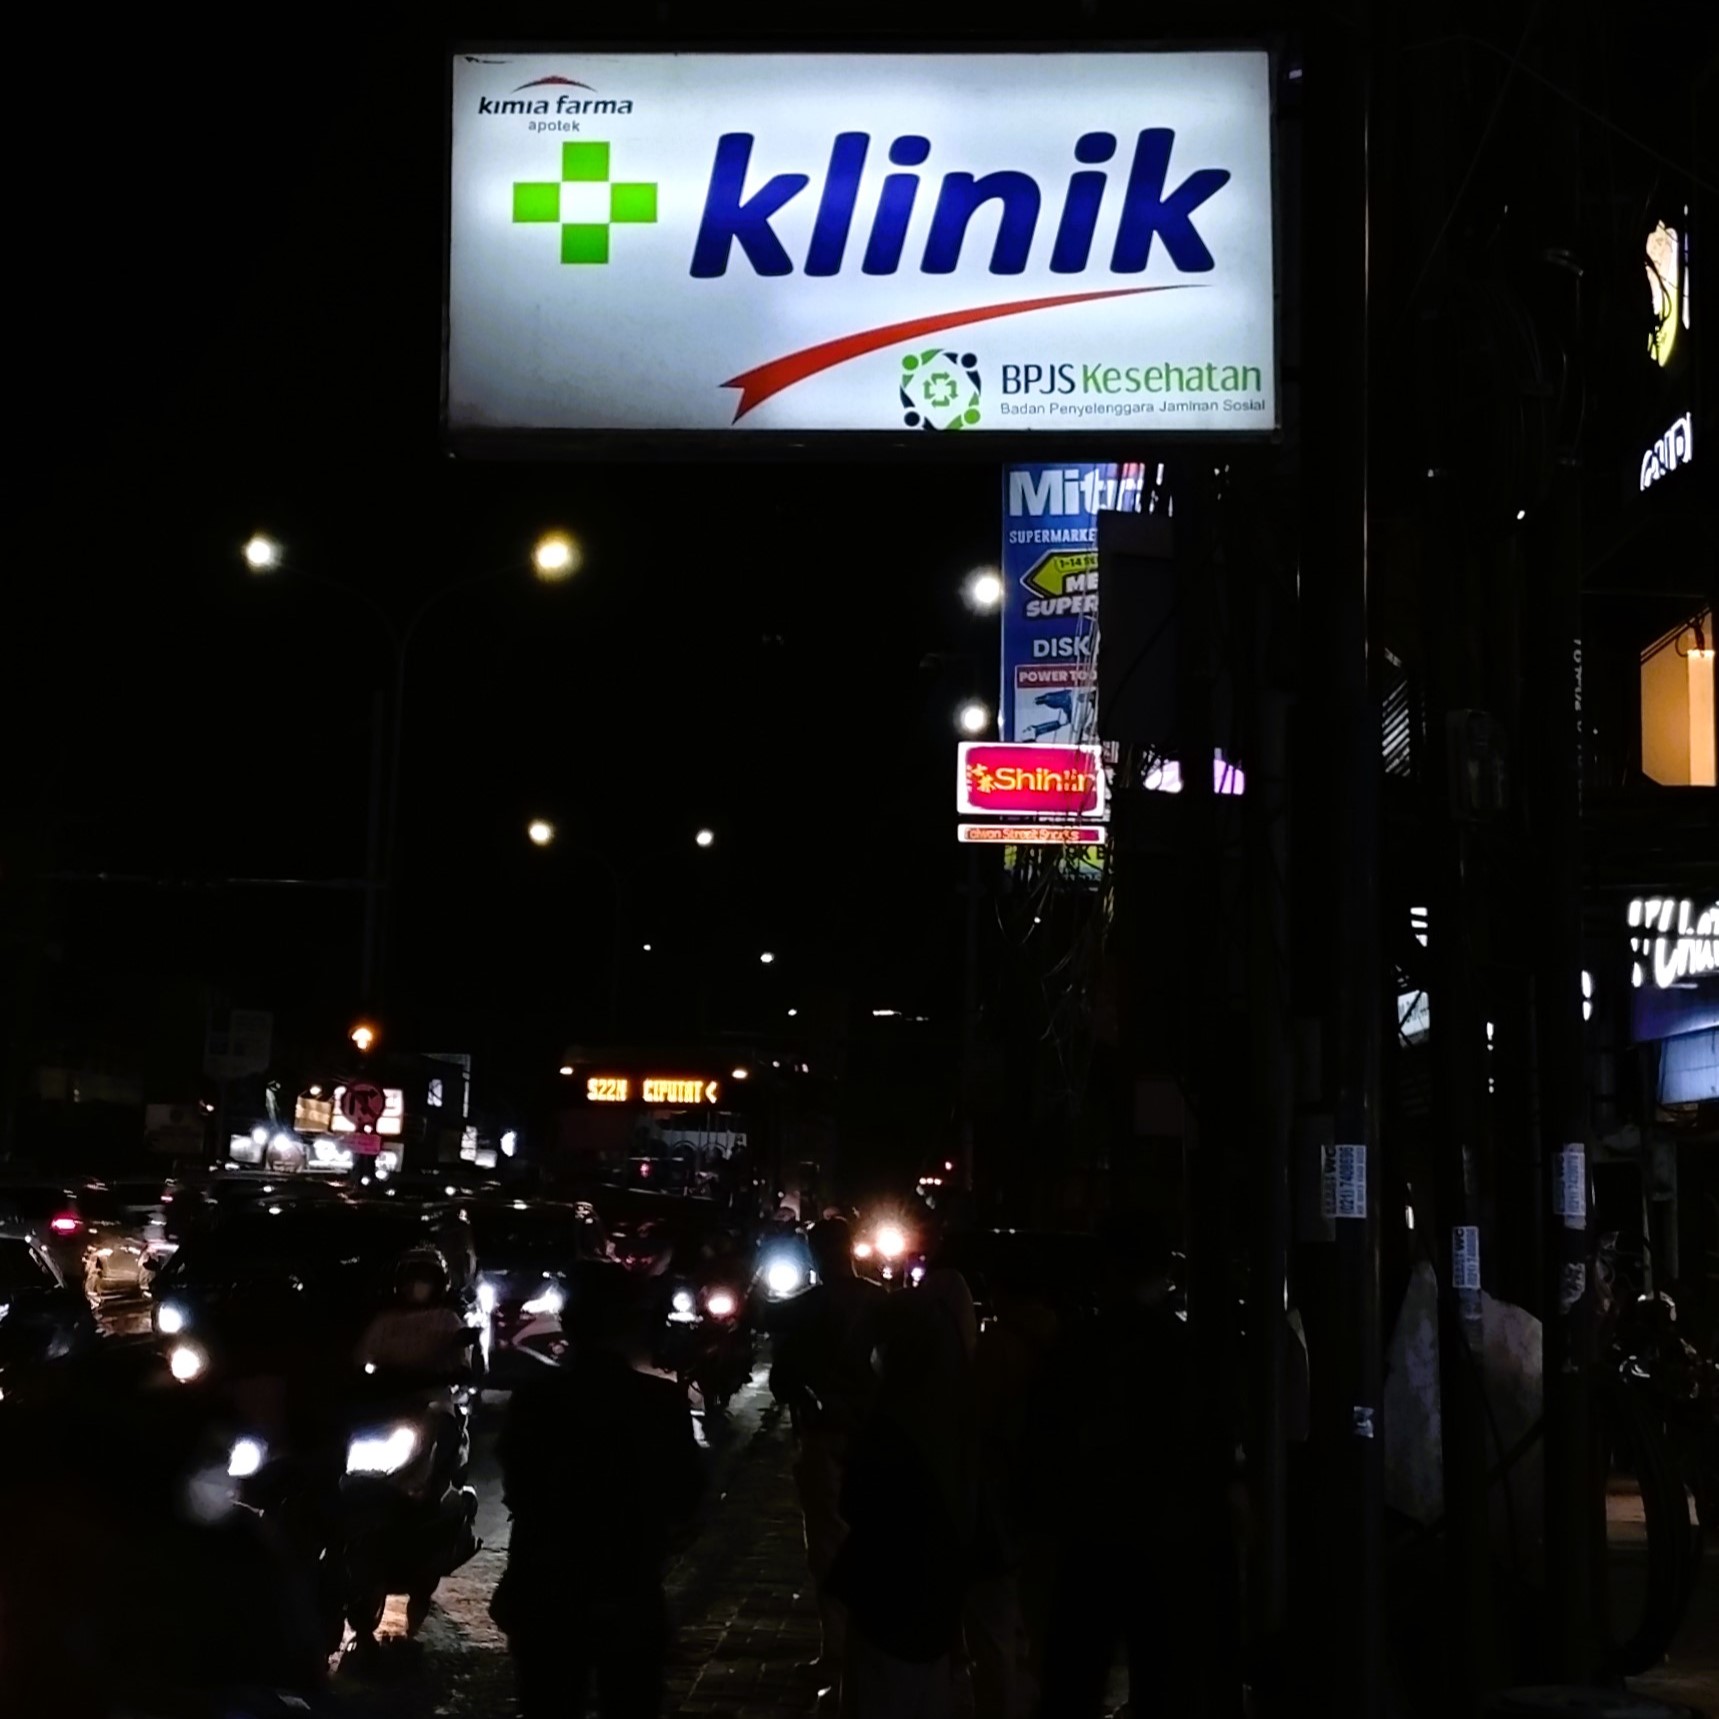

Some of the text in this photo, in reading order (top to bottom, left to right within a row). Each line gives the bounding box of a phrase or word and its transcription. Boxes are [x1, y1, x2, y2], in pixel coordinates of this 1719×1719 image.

[478, 95, 634, 115] kimia farma
[528, 120, 580, 133] apotek
[689, 127, 1232, 279] klinik
[1001, 361, 1262, 395] BPJS Kesehatan
[1000, 399, 1266, 418] Badan Penyelenggara Jaminan Sosial
[1018, 670, 1068, 683] POWER
